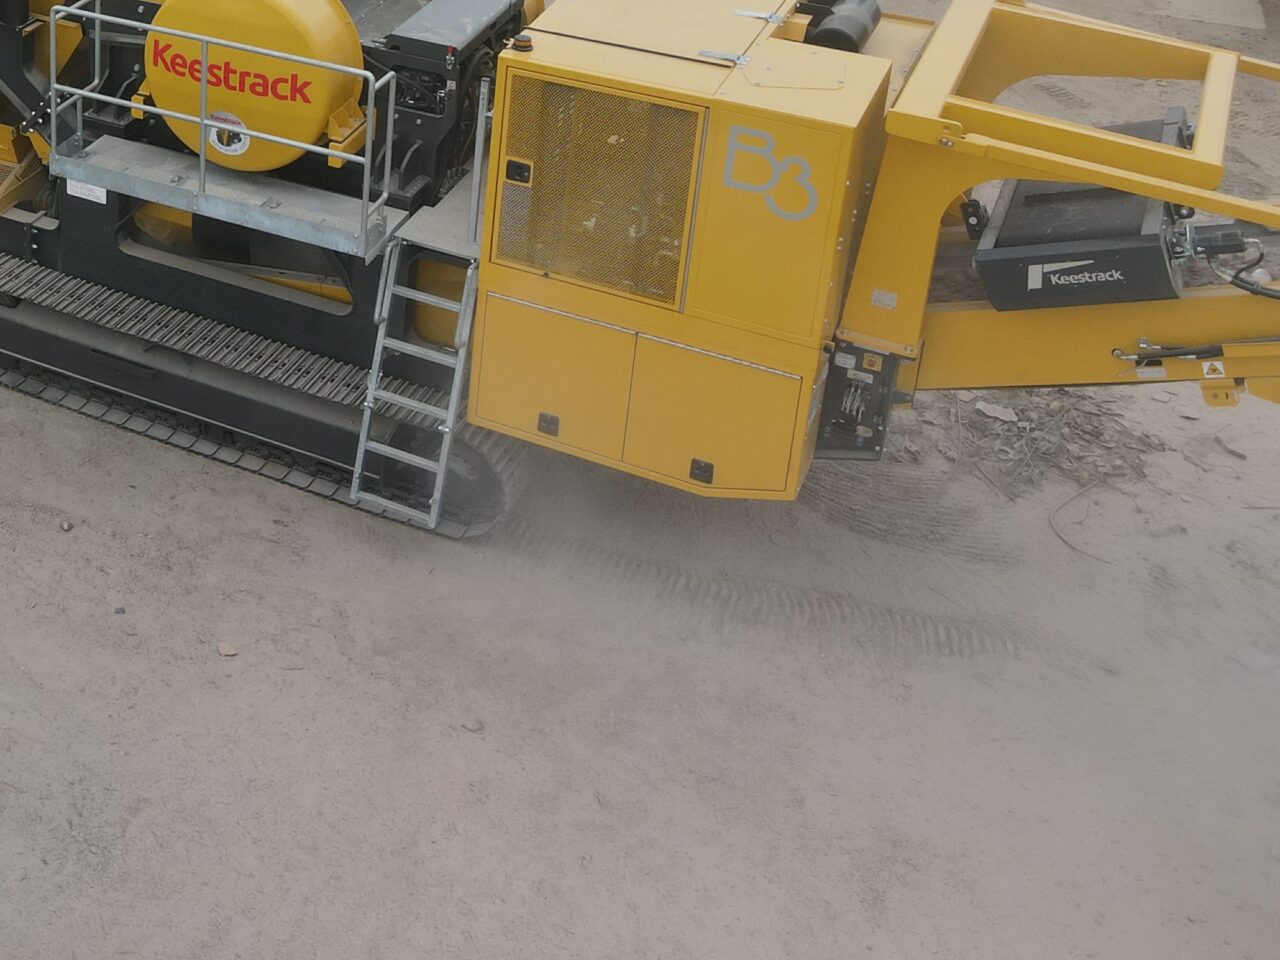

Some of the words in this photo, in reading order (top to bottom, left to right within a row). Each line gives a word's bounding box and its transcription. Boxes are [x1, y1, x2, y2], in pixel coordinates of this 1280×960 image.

[152, 38, 313, 105] Keestrack
[723, 125, 819, 222] B3
[1049, 268, 1125, 286] Keestrack
